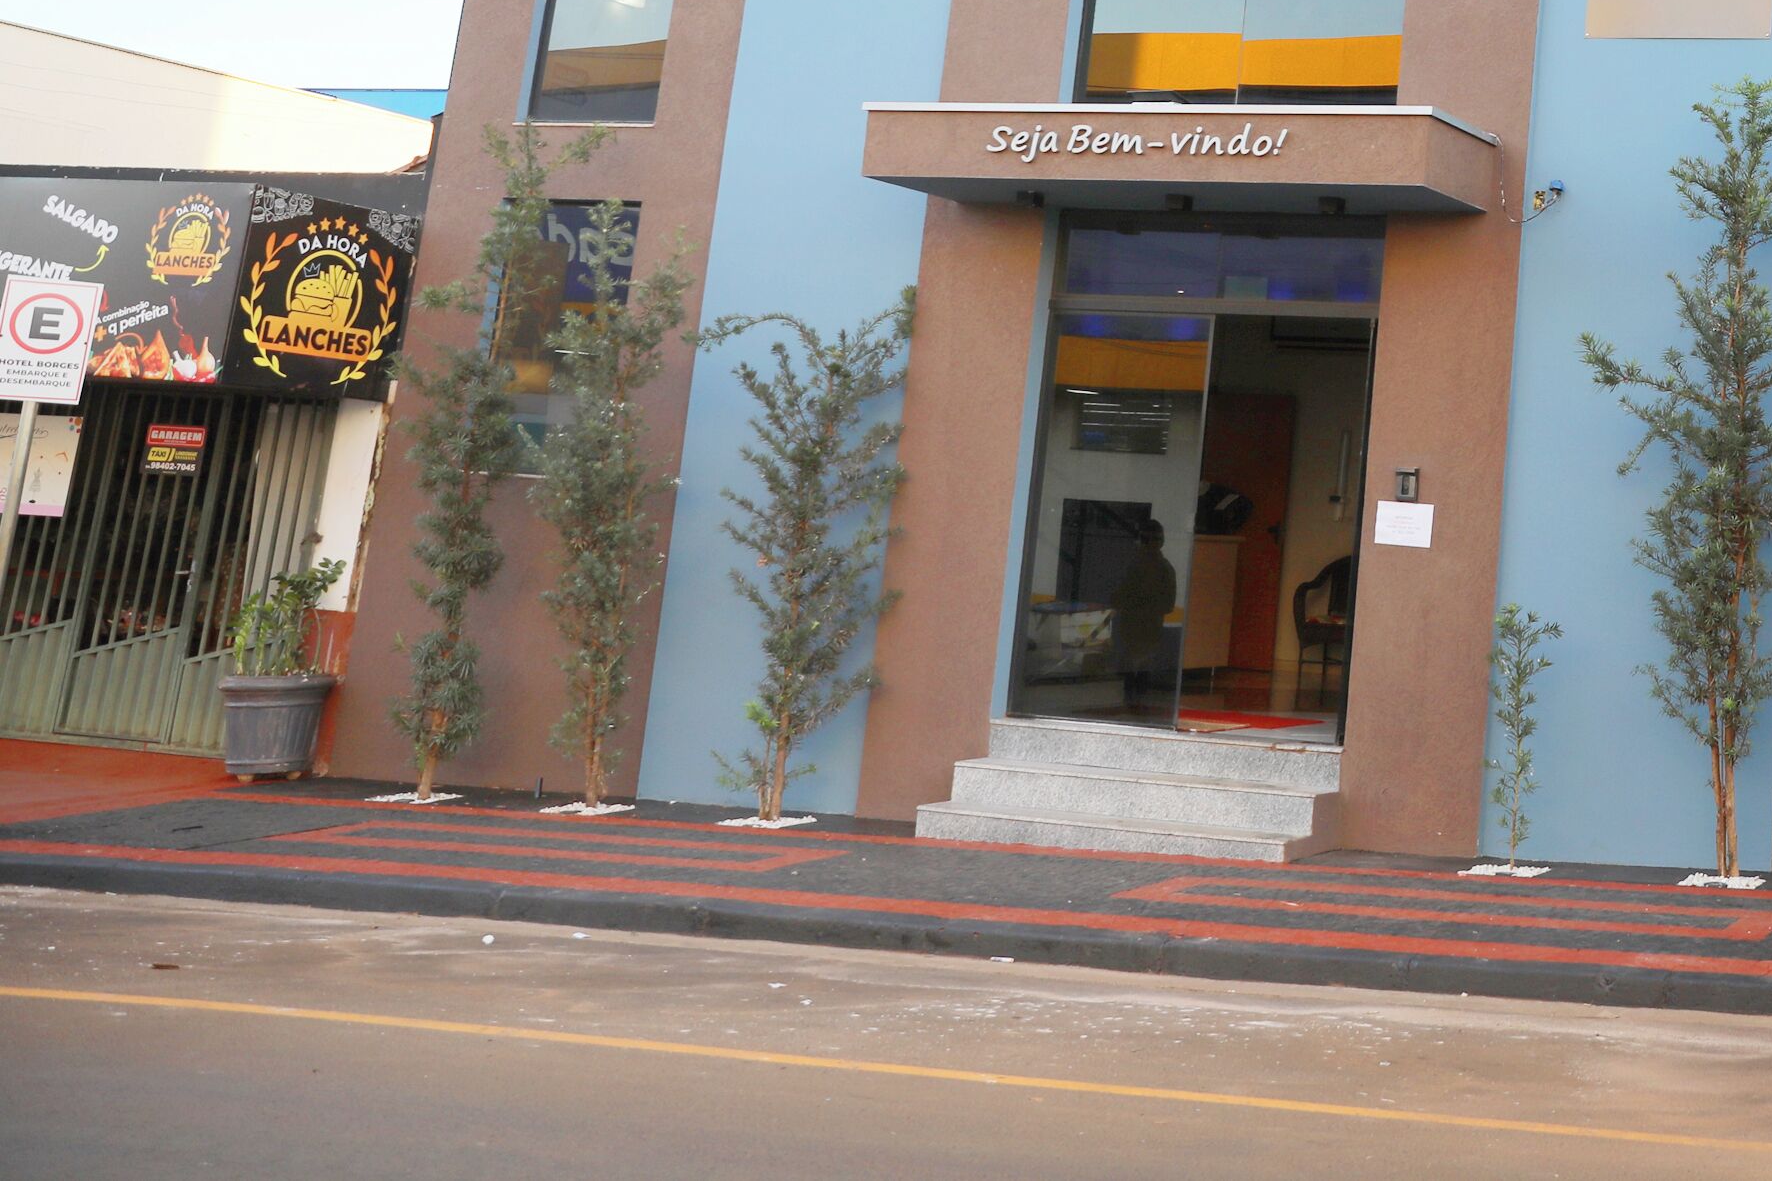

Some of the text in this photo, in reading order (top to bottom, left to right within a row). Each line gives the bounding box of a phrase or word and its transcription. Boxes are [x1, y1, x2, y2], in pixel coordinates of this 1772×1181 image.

[986, 122, 1289, 164] Seja Bem-vindo!
[43, 194, 119, 244] SALGADO
[176, 203, 214, 220] DA HORA
[156, 254, 214, 269] LANCHES
[298, 234, 368, 269] DA HORA
[0, 249, 74, 281] GERANTE
[102, 300, 150, 323] combinação
[108, 323, 117, 335] q
[119, 303, 169, 332] perfeita
[28, 306, 65, 341] E
[261, 320, 369, 357] LANCHES
[0, 358, 80, 371] HOTEL BORGES
[6, 368, 60, 379] EMBARQUE
[0, 377, 72, 388] DESEMBARQUE
[151, 429, 203, 442] GARAGEM
[151, 450, 167, 458] TAXI
[150, 461, 196, 472] 98402-7045
